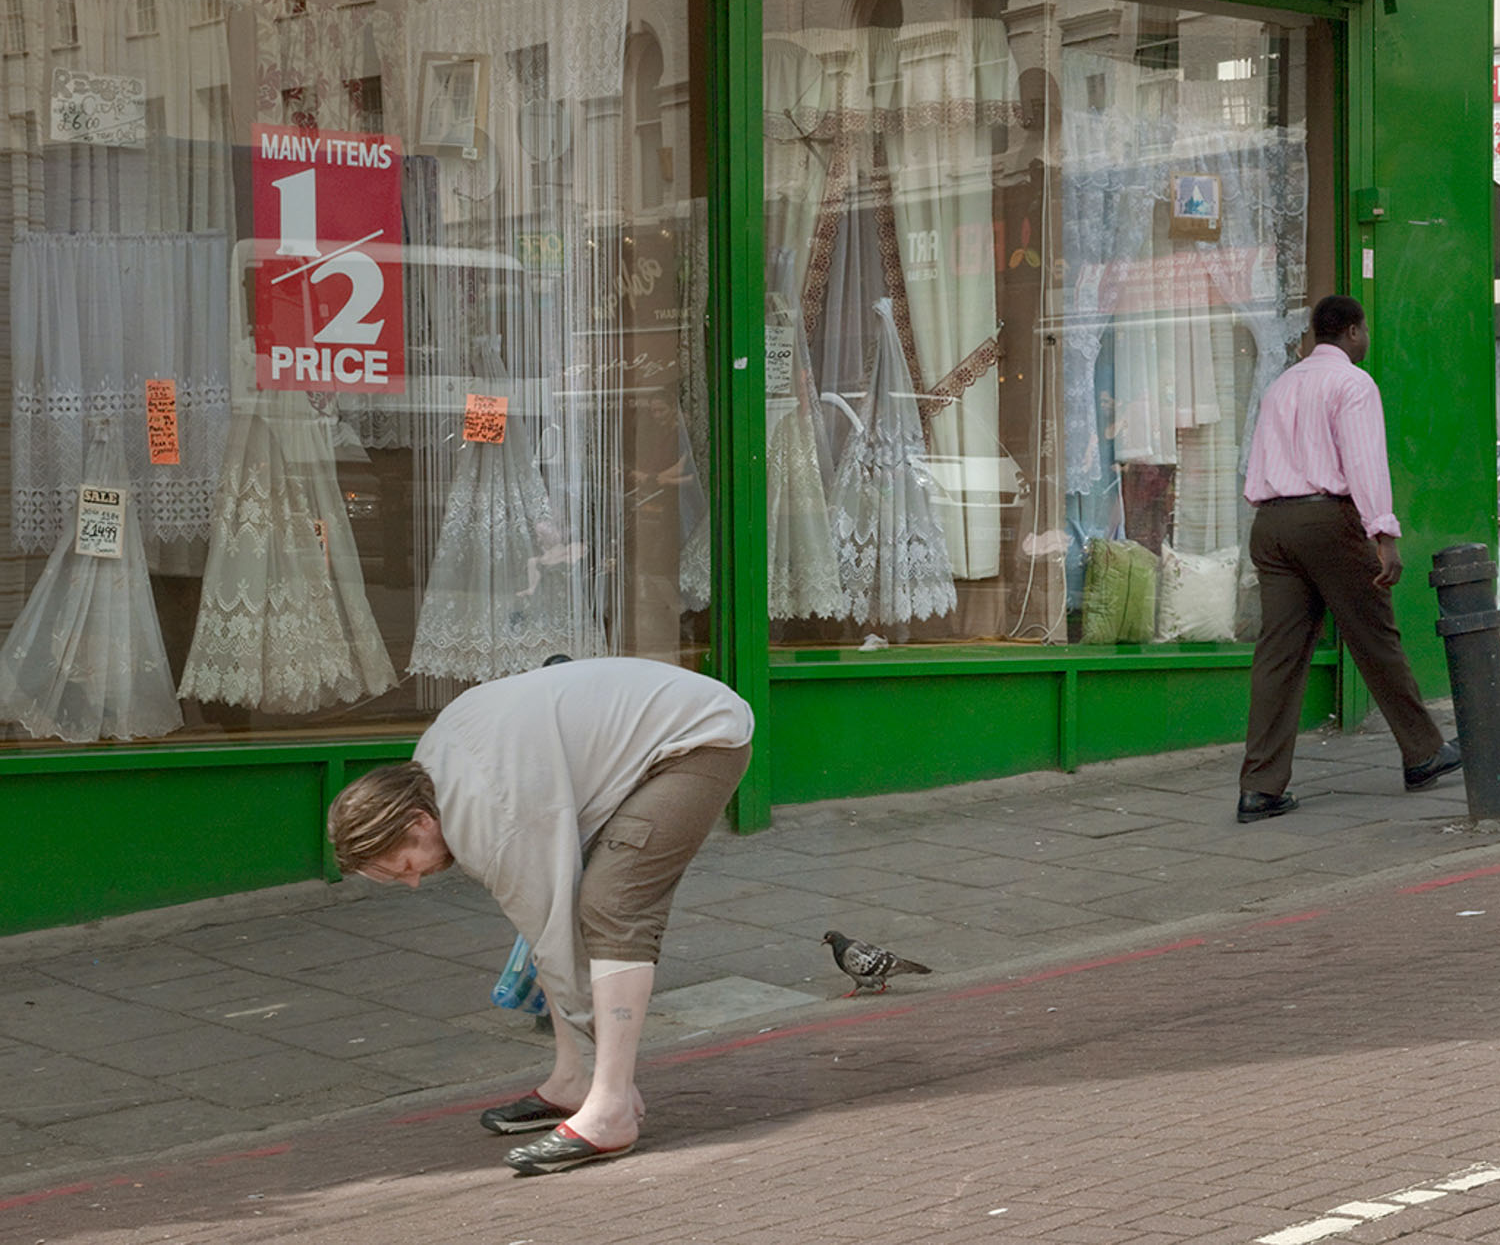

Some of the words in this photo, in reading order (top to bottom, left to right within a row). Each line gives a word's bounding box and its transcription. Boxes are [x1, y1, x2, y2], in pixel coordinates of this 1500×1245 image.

[261, 133, 320, 164] MANY
[326, 139, 393, 170] ITEMS
[271, 346, 389, 385] PRICE
[84, 490, 119, 504] SALE
